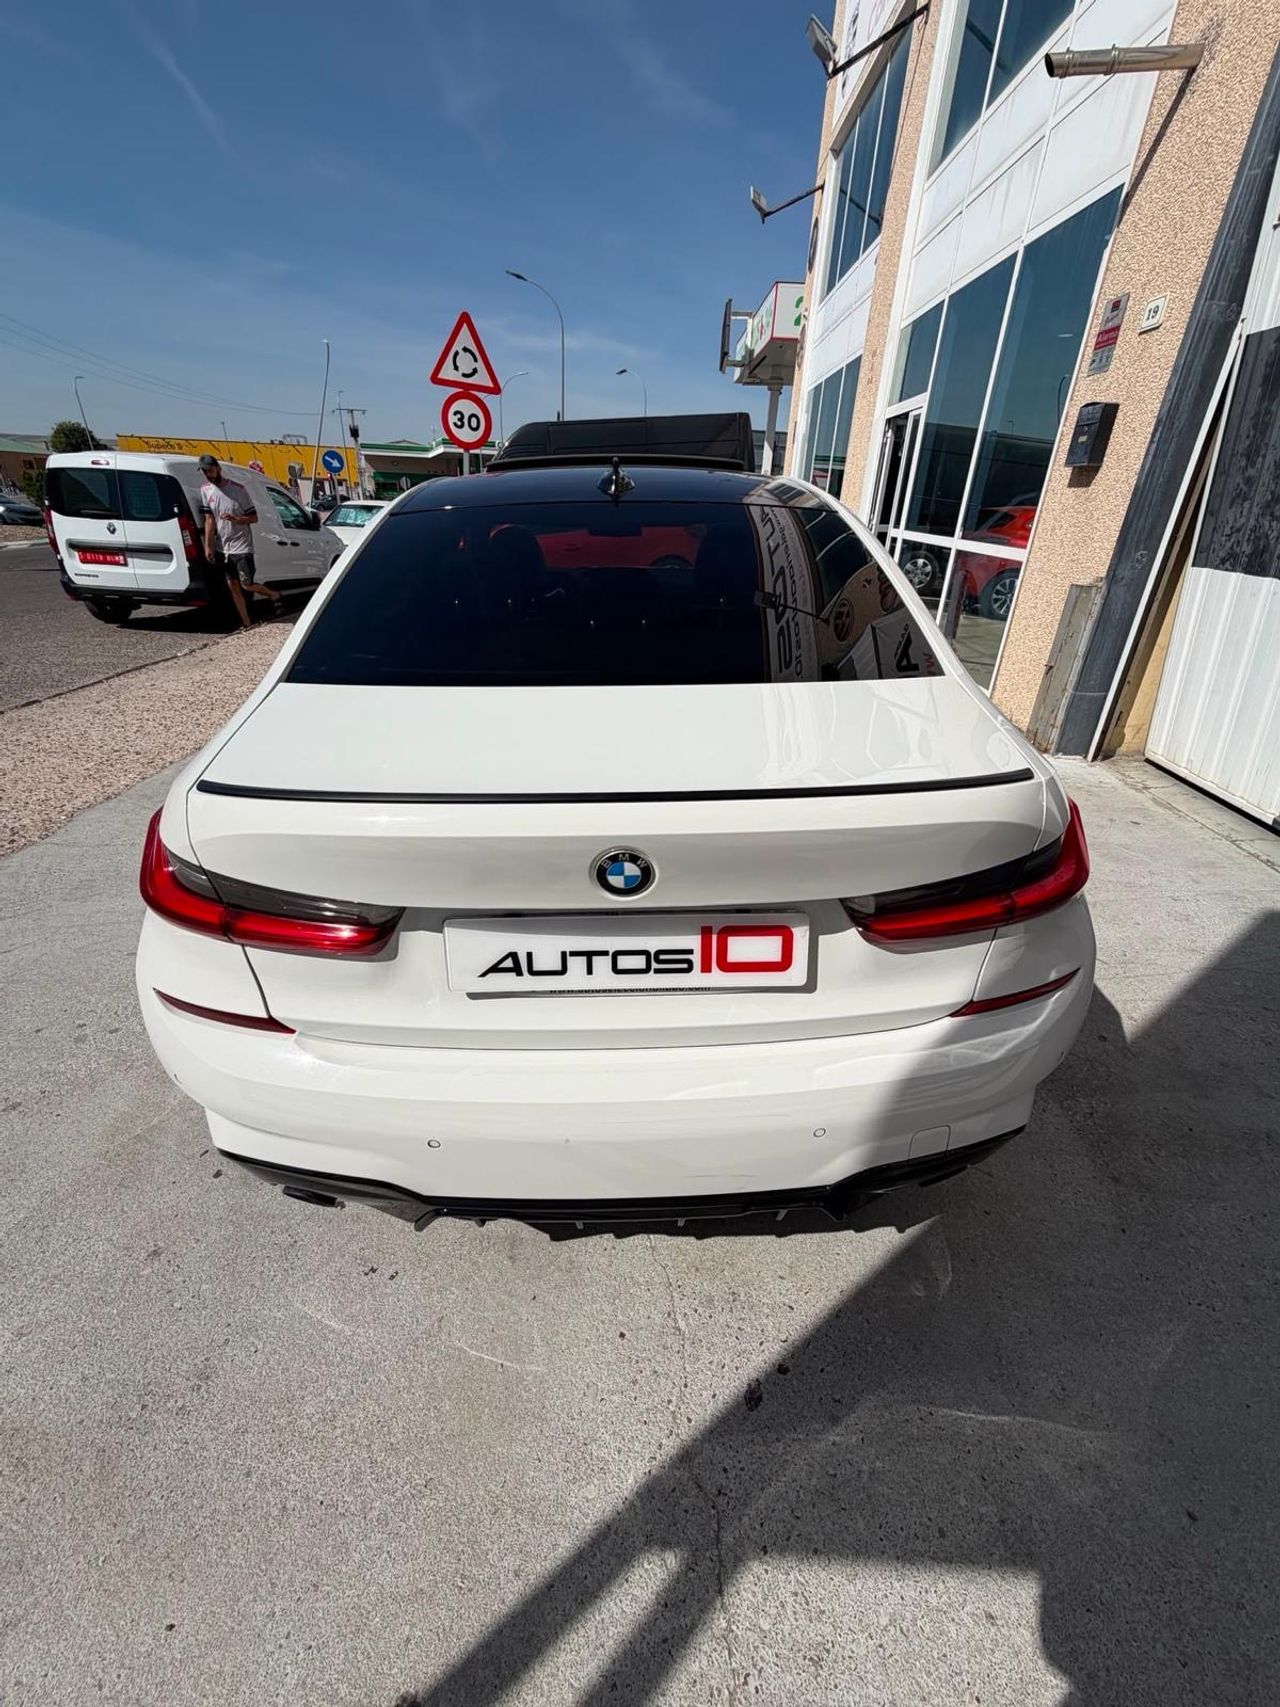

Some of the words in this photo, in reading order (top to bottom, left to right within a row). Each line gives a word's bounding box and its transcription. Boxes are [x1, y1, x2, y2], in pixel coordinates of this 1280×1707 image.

[1146, 305, 1160, 321] 19
[453, 410, 481, 432] 30
[601, 853, 648, 869] BMW
[477, 924, 794, 978] AUTOS10
